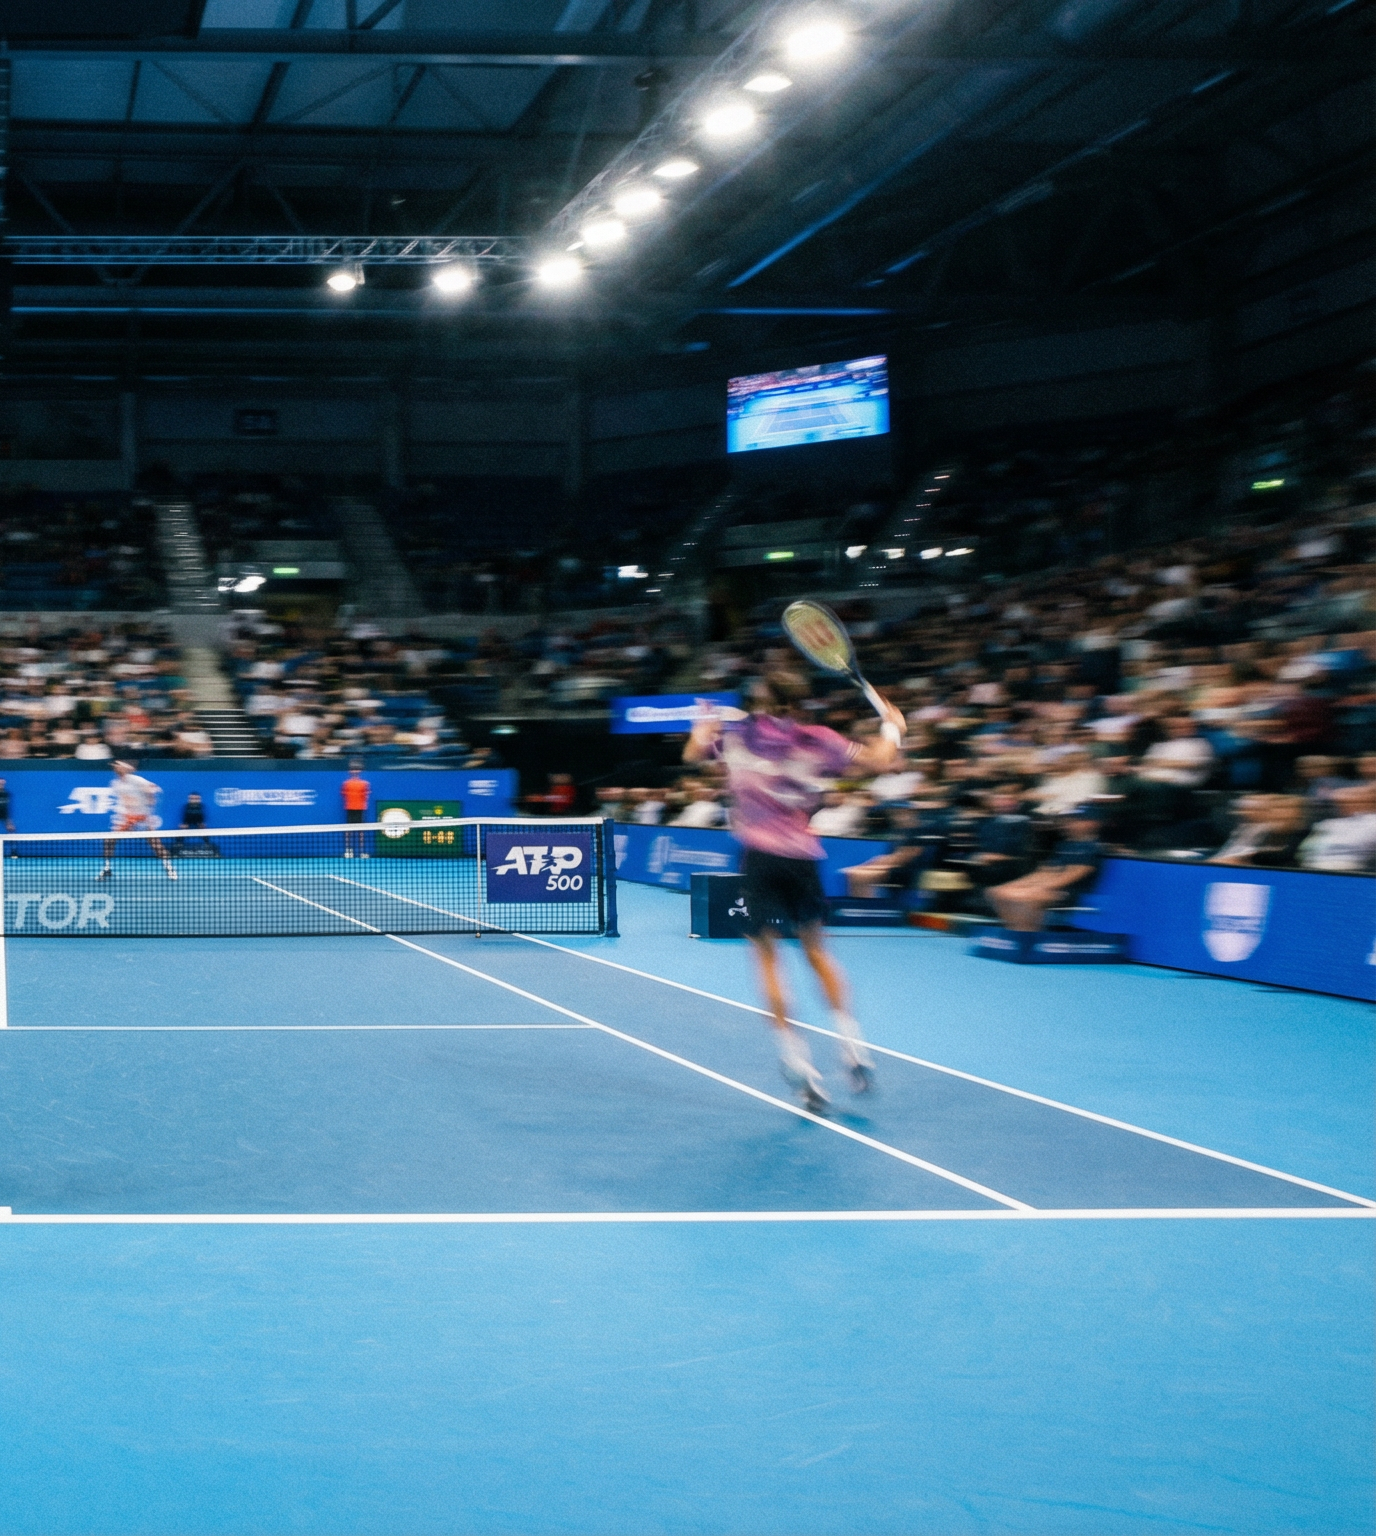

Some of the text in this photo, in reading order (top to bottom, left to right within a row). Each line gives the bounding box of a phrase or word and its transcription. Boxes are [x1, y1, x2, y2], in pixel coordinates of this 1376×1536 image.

[491, 846, 583, 876] ATP
[546, 875, 583, 891] 500
[6, 892, 115, 929] TOR
